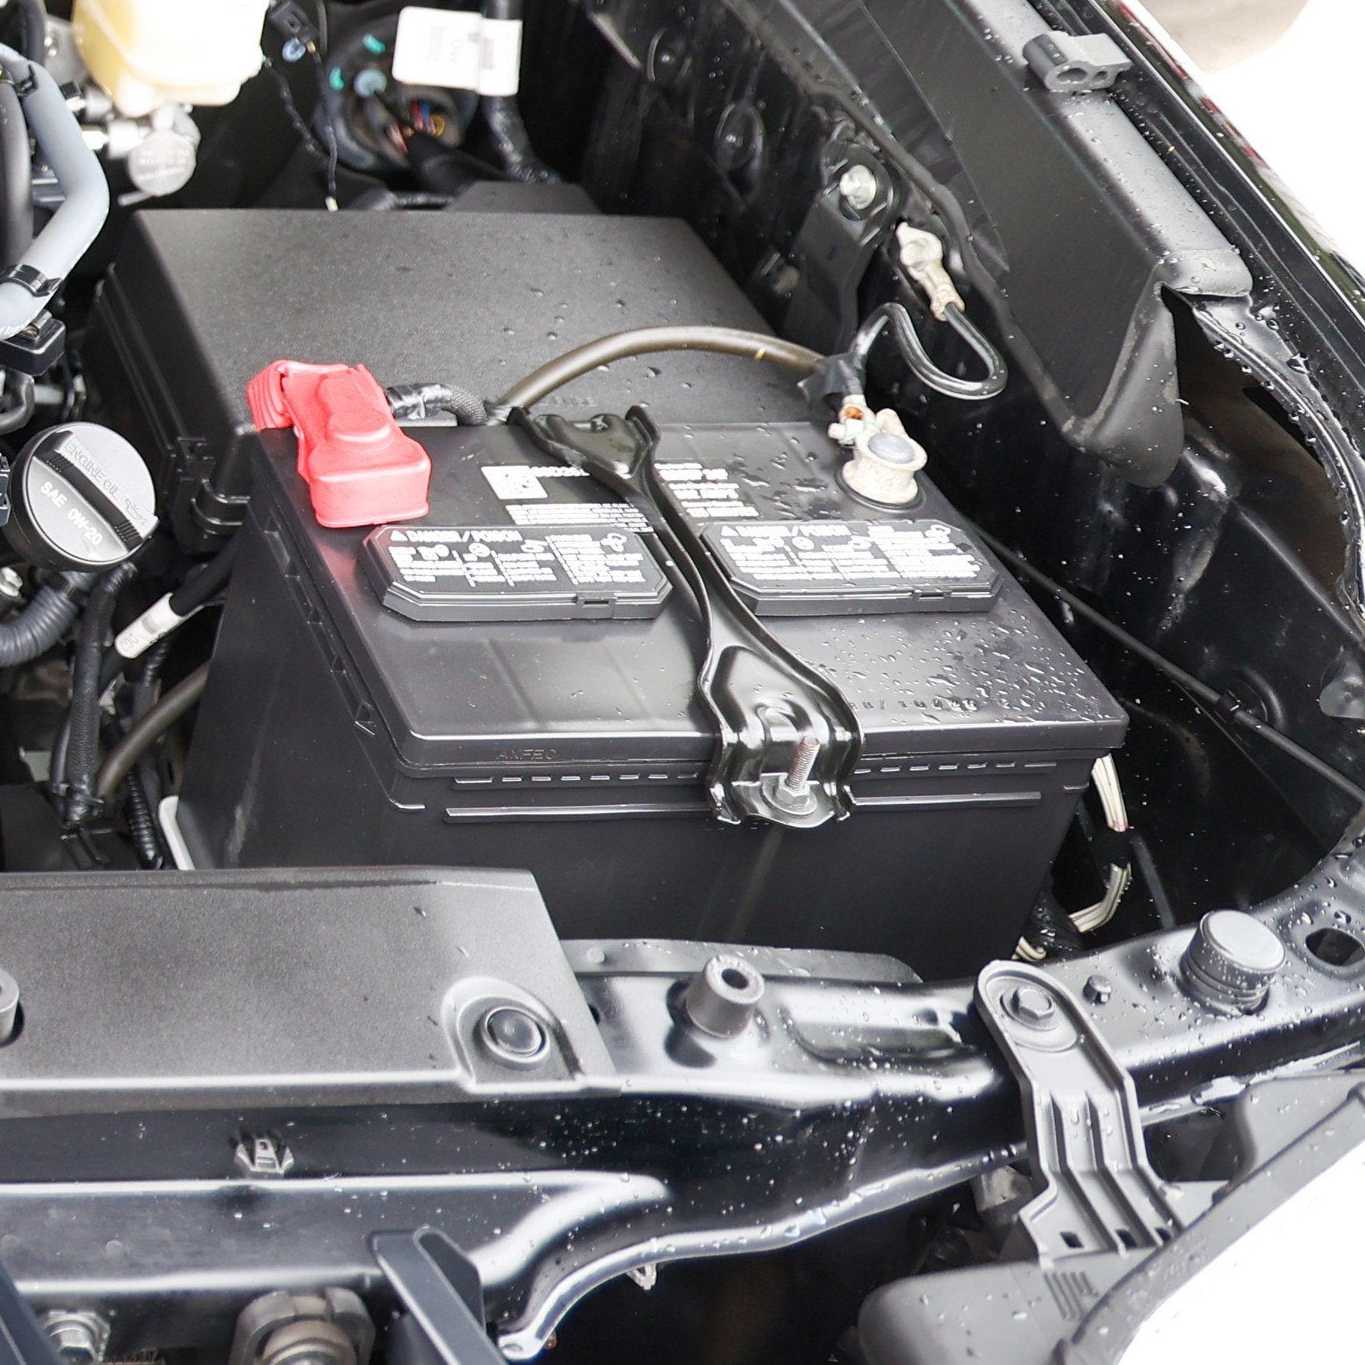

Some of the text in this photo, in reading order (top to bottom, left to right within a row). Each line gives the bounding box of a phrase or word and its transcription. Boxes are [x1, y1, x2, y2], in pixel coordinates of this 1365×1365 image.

[65, 440, 121, 501] ENGINE OIL
[40, 481, 68, 509] SAE
